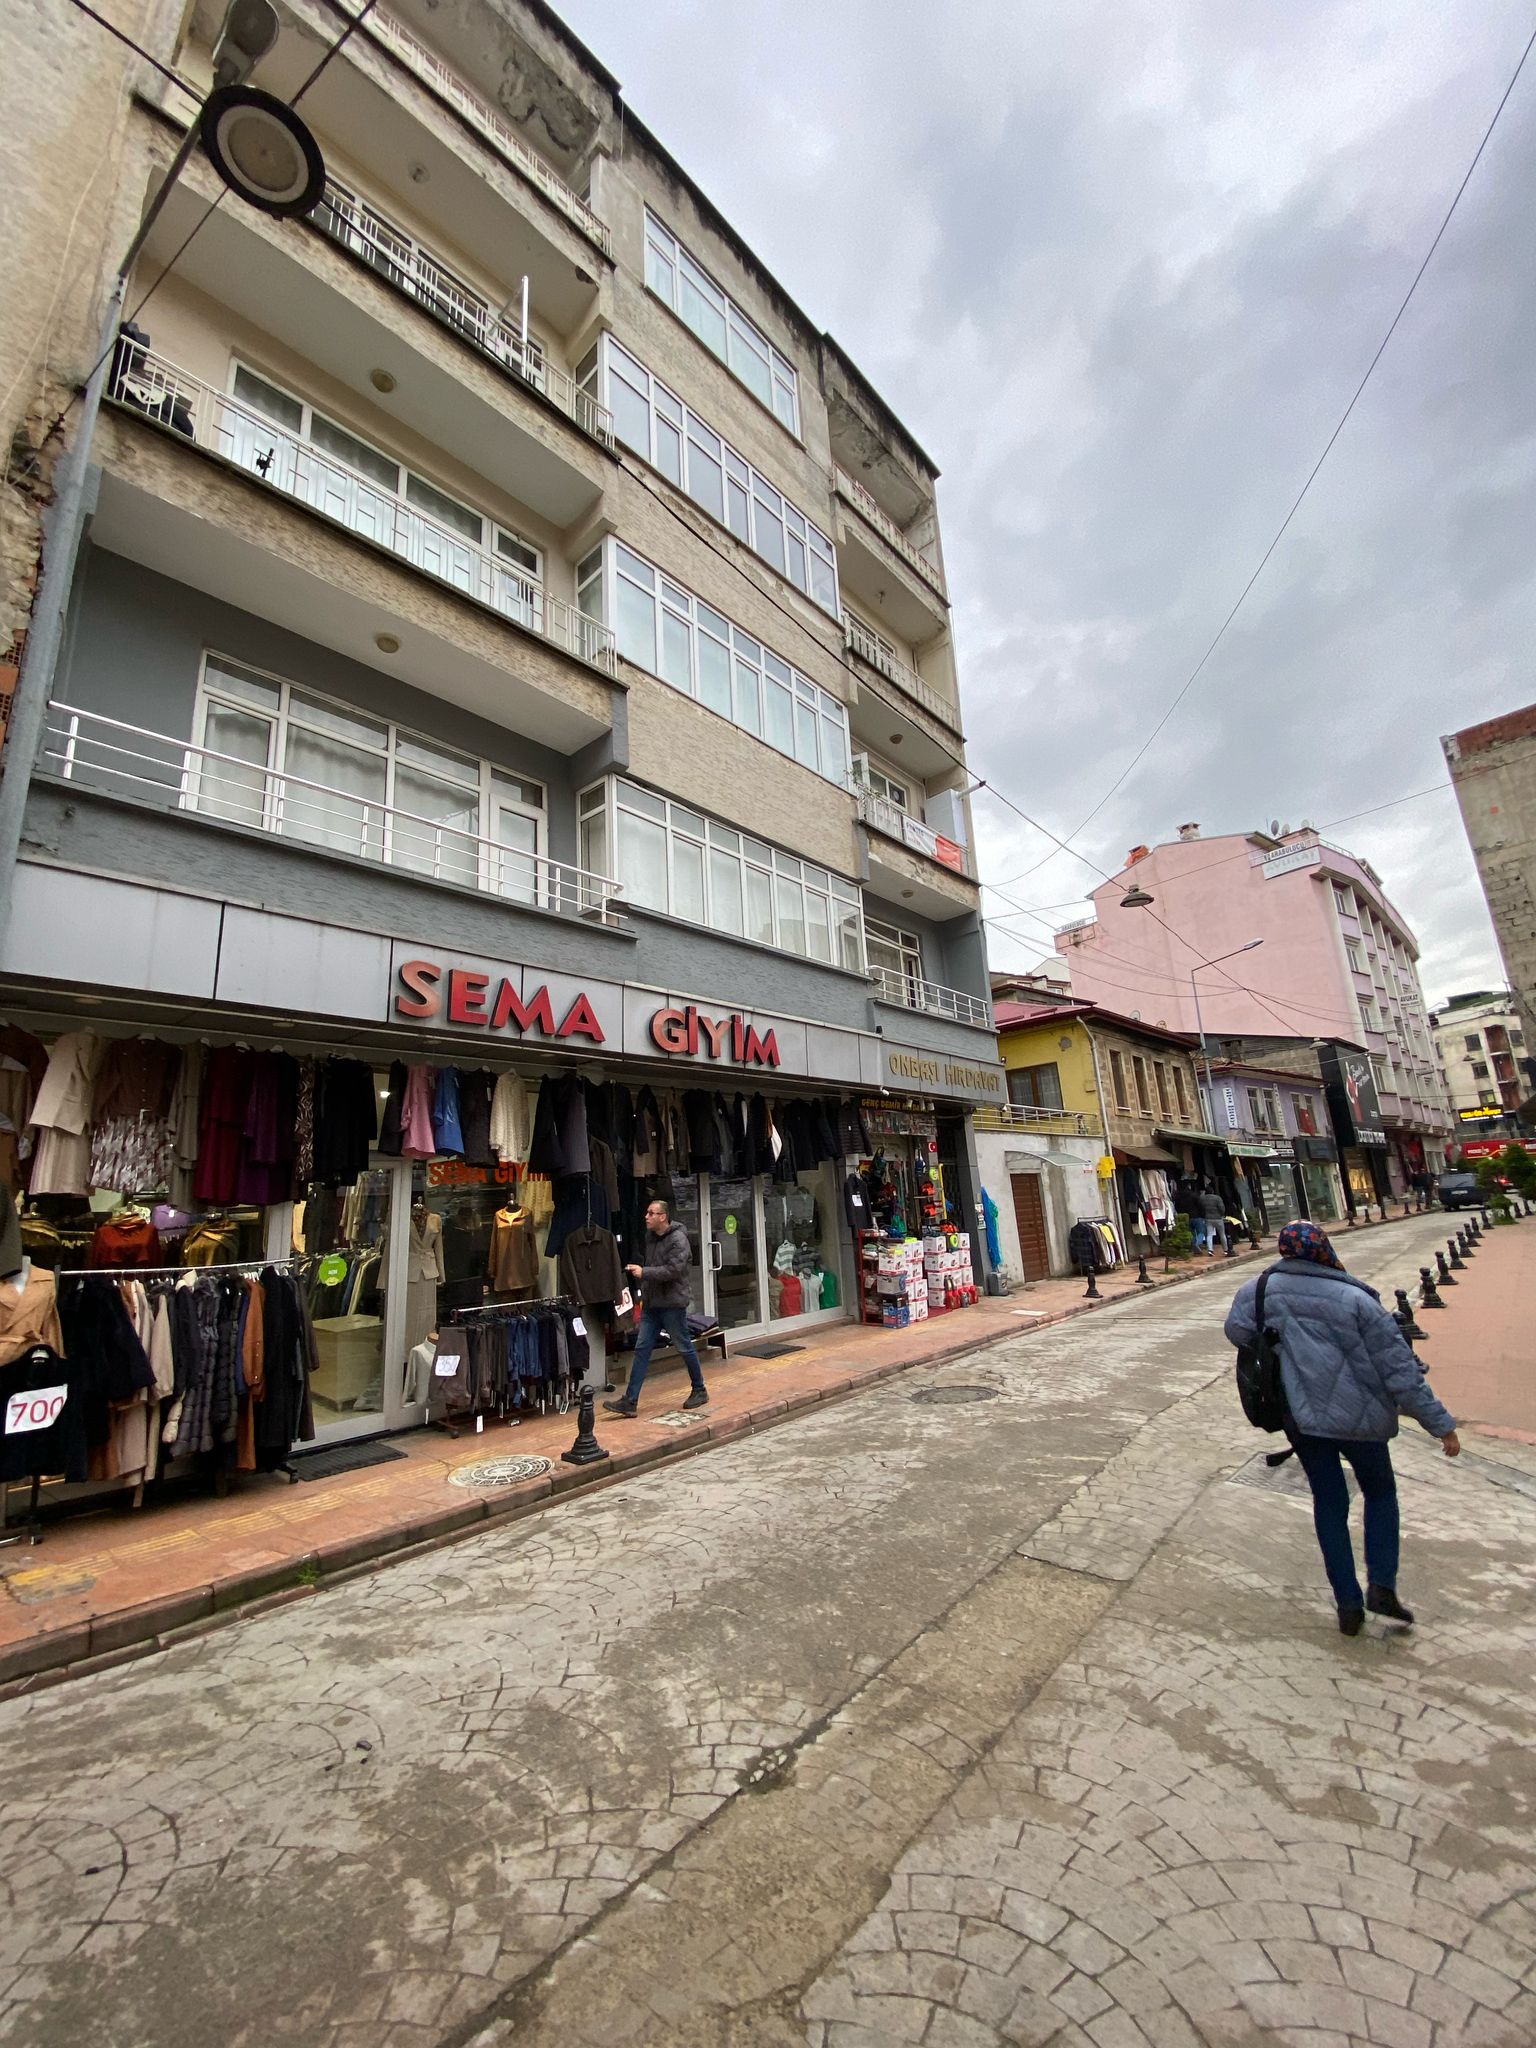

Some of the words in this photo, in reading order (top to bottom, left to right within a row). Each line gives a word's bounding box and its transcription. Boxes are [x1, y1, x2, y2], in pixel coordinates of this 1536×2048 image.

[395, 960, 606, 1042] SEMA
[649, 1005, 781, 1066] GİYİM
[889, 1053, 940, 1085] ONBAŞI
[944, 1063, 1001, 1092] HIRDAVAT
[11, 1396, 65, 1428] 700
